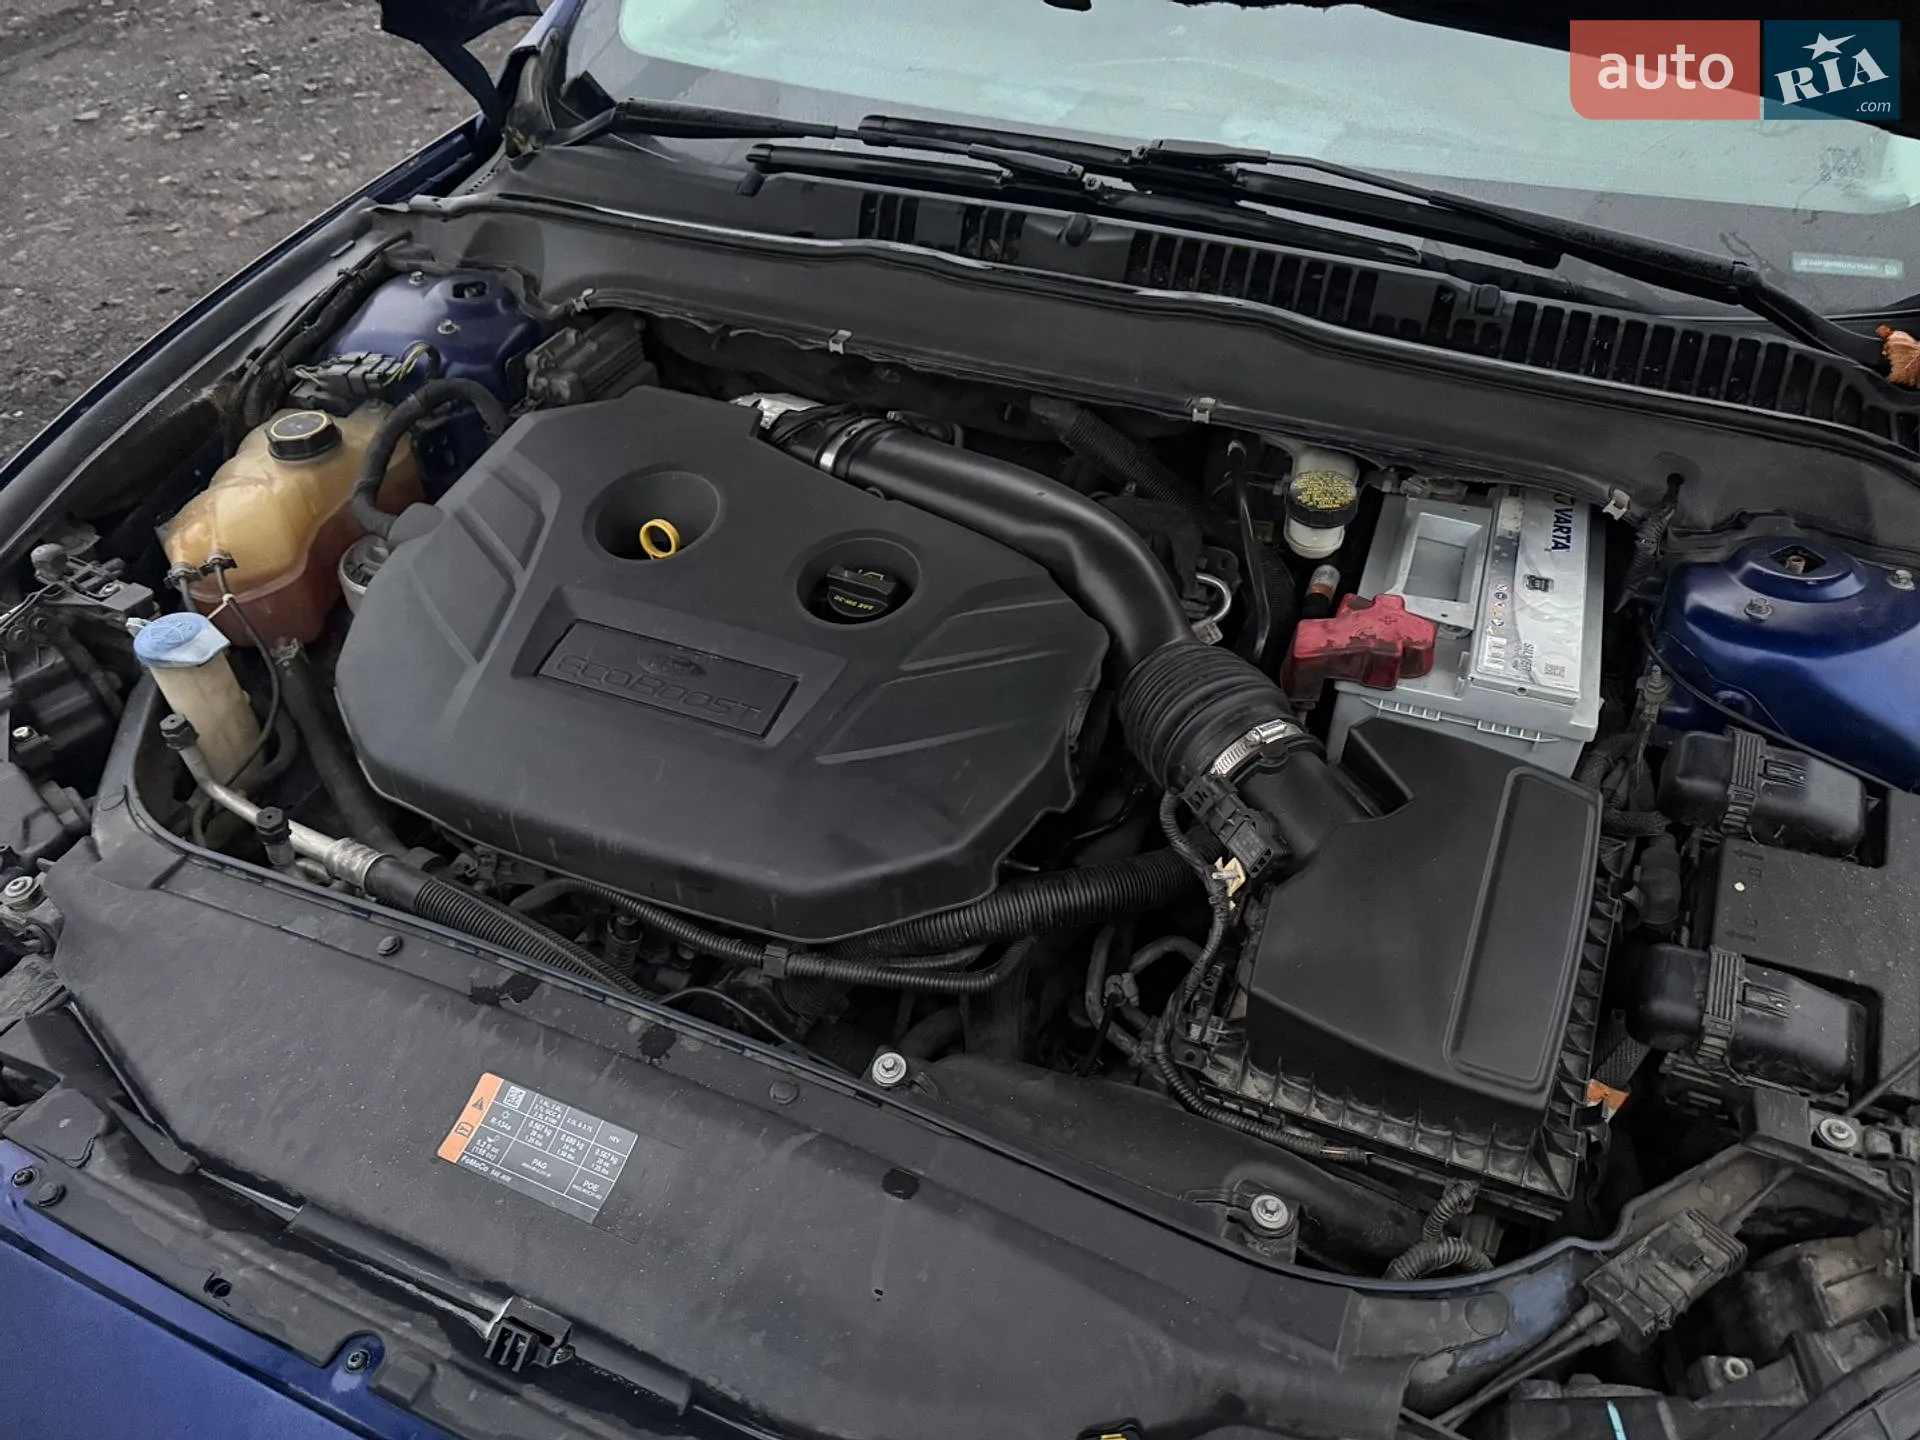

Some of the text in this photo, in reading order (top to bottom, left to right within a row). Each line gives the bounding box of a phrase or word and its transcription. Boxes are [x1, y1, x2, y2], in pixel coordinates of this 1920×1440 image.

[1551, 508, 1573, 552] VARTA
[461, 1155, 489, 1172] FoMoCo
[530, 1157, 549, 1170] PAG
[582, 1179, 600, 1192] POE
